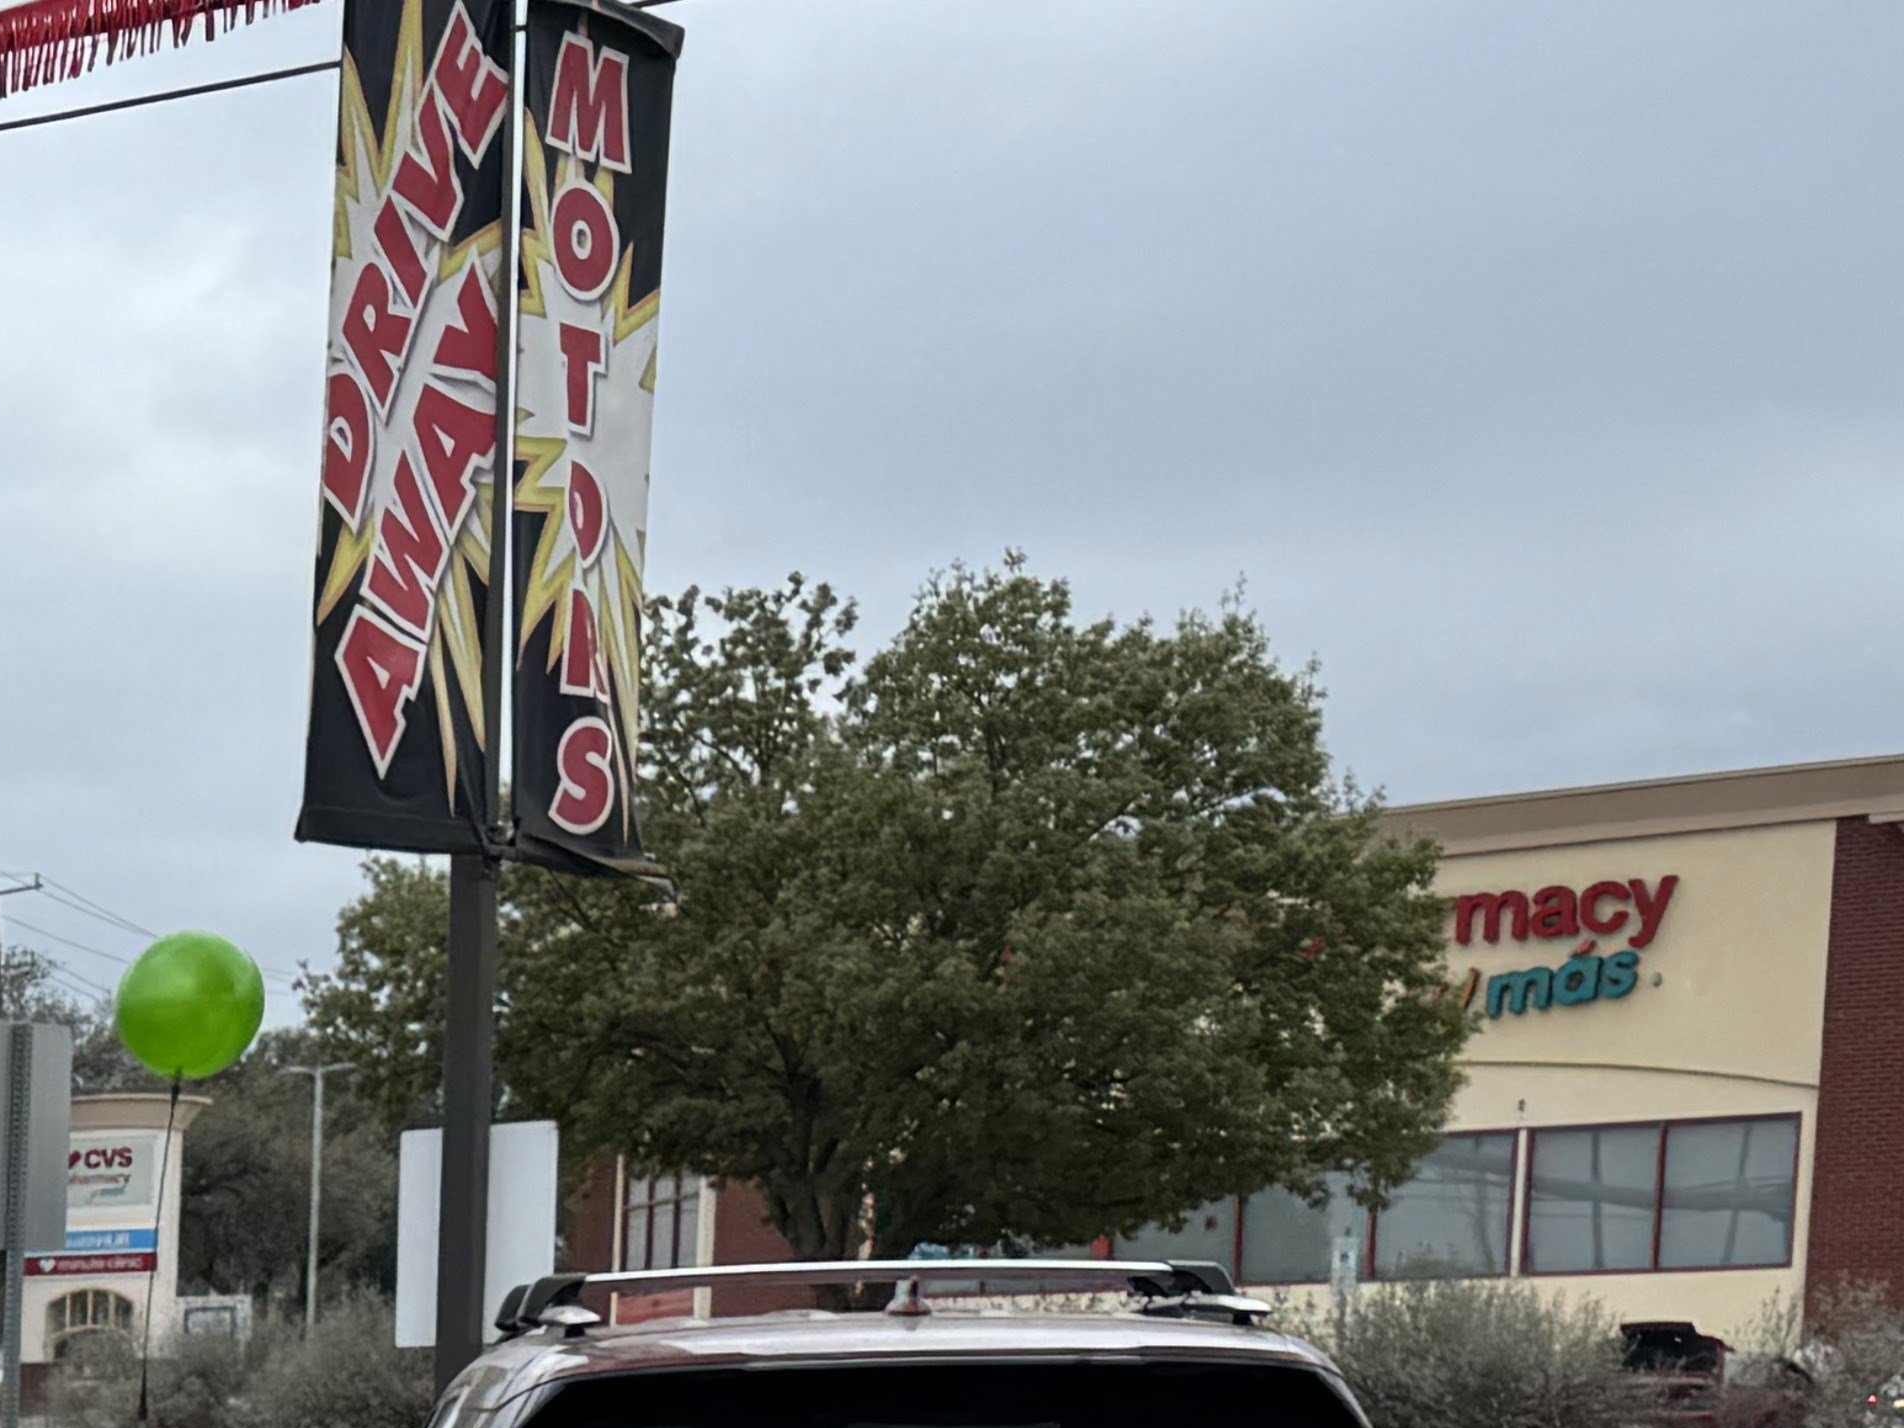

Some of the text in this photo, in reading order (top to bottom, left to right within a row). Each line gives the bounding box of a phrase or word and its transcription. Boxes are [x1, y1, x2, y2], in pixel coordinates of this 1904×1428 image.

[322, 0, 508, 532] DRIVE
[335, 246, 498, 780] AWAY
[1486, 938, 1640, 1020] más
[84, 1146, 133, 1169] CVS
